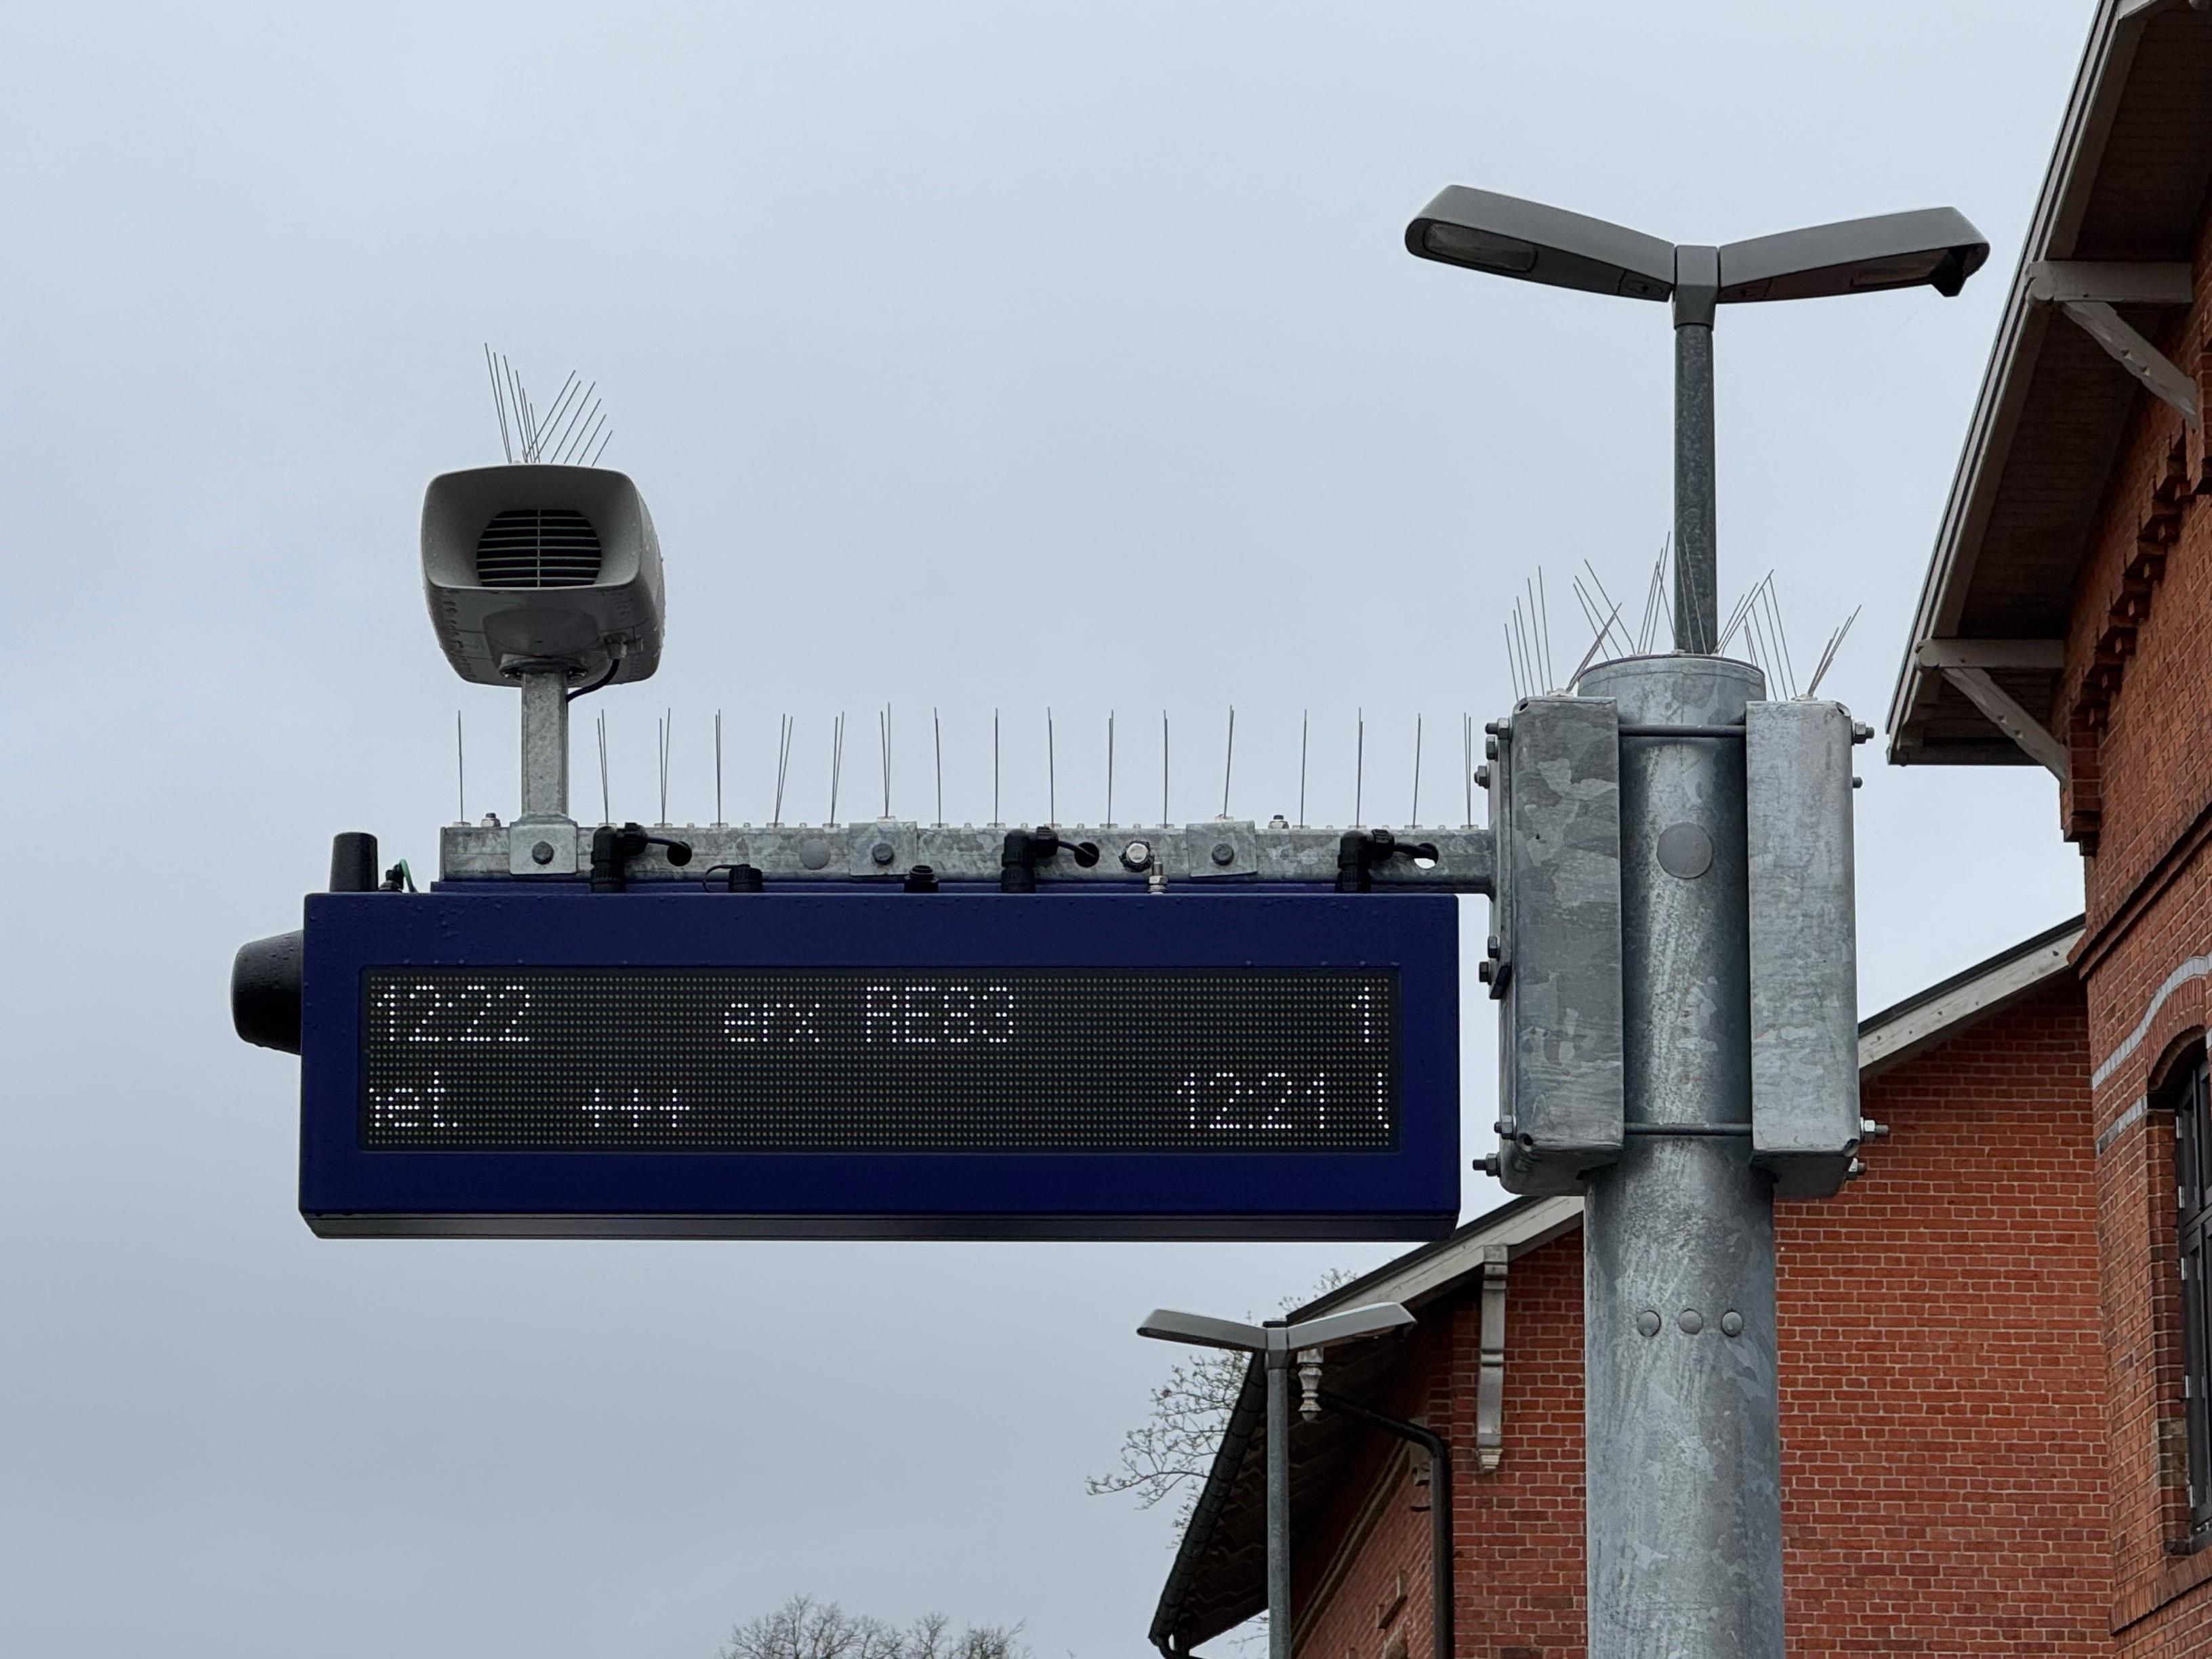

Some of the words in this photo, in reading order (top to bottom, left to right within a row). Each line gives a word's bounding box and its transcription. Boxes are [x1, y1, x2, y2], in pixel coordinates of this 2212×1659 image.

[377, 985, 531, 1042] 12:22
[724, 1003, 820, 1042] erx
[865, 986, 1014, 1043] RE83
[1351, 987, 1370, 1043] 1
[1176, 1072, 1325, 1129] 12:21
